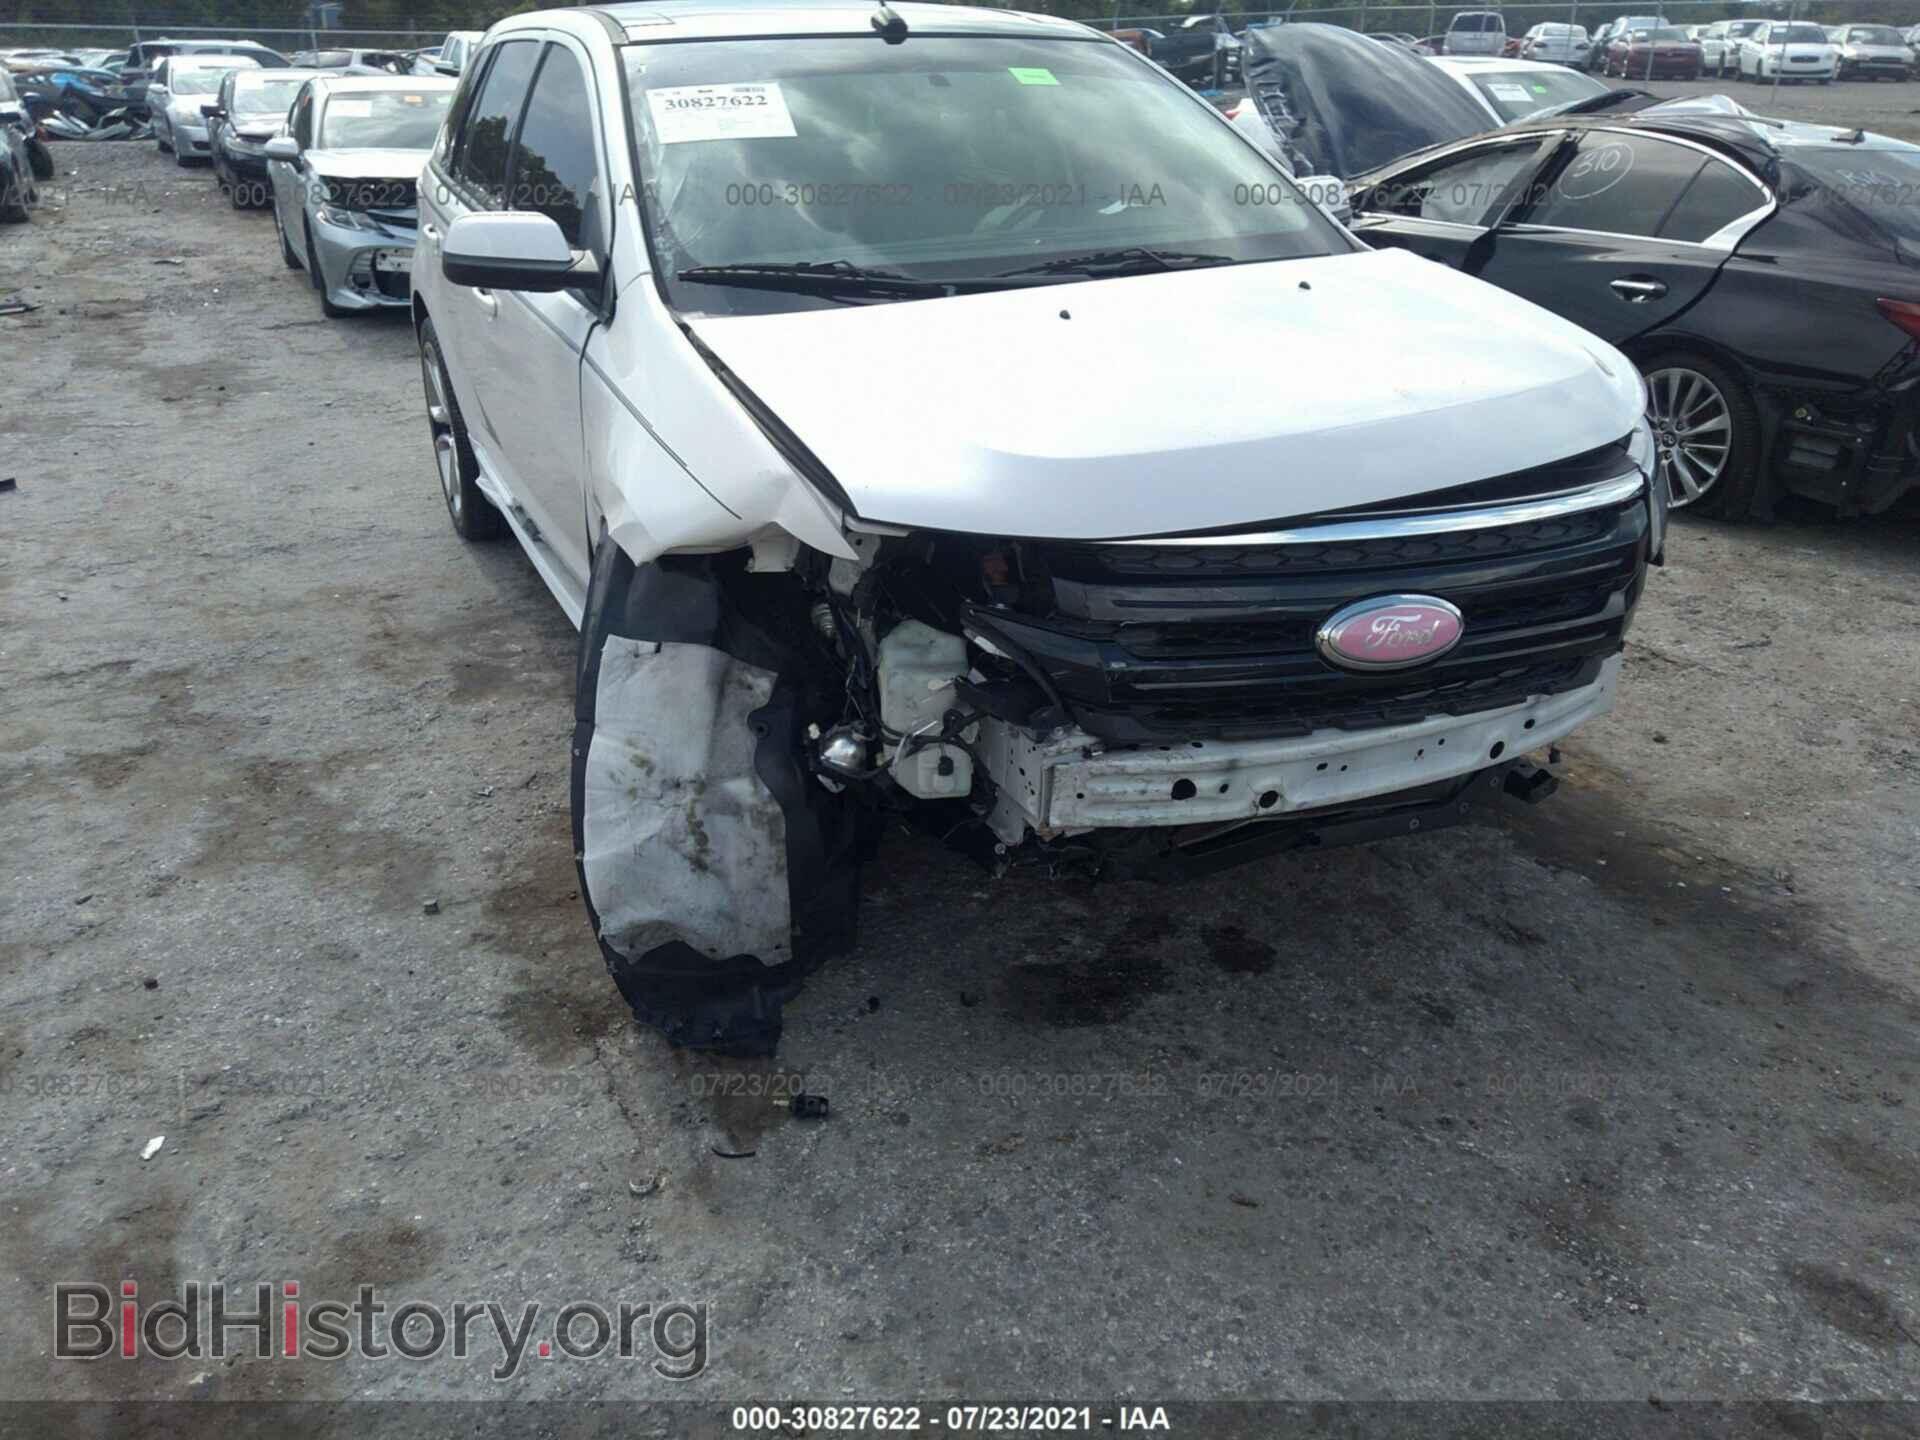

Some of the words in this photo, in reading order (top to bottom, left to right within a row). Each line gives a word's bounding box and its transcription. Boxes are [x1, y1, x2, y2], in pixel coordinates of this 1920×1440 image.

[664, 95, 768, 111] 30827622
[1573, 150, 1621, 178] 310
[1365, 613, 1441, 649] Ford
